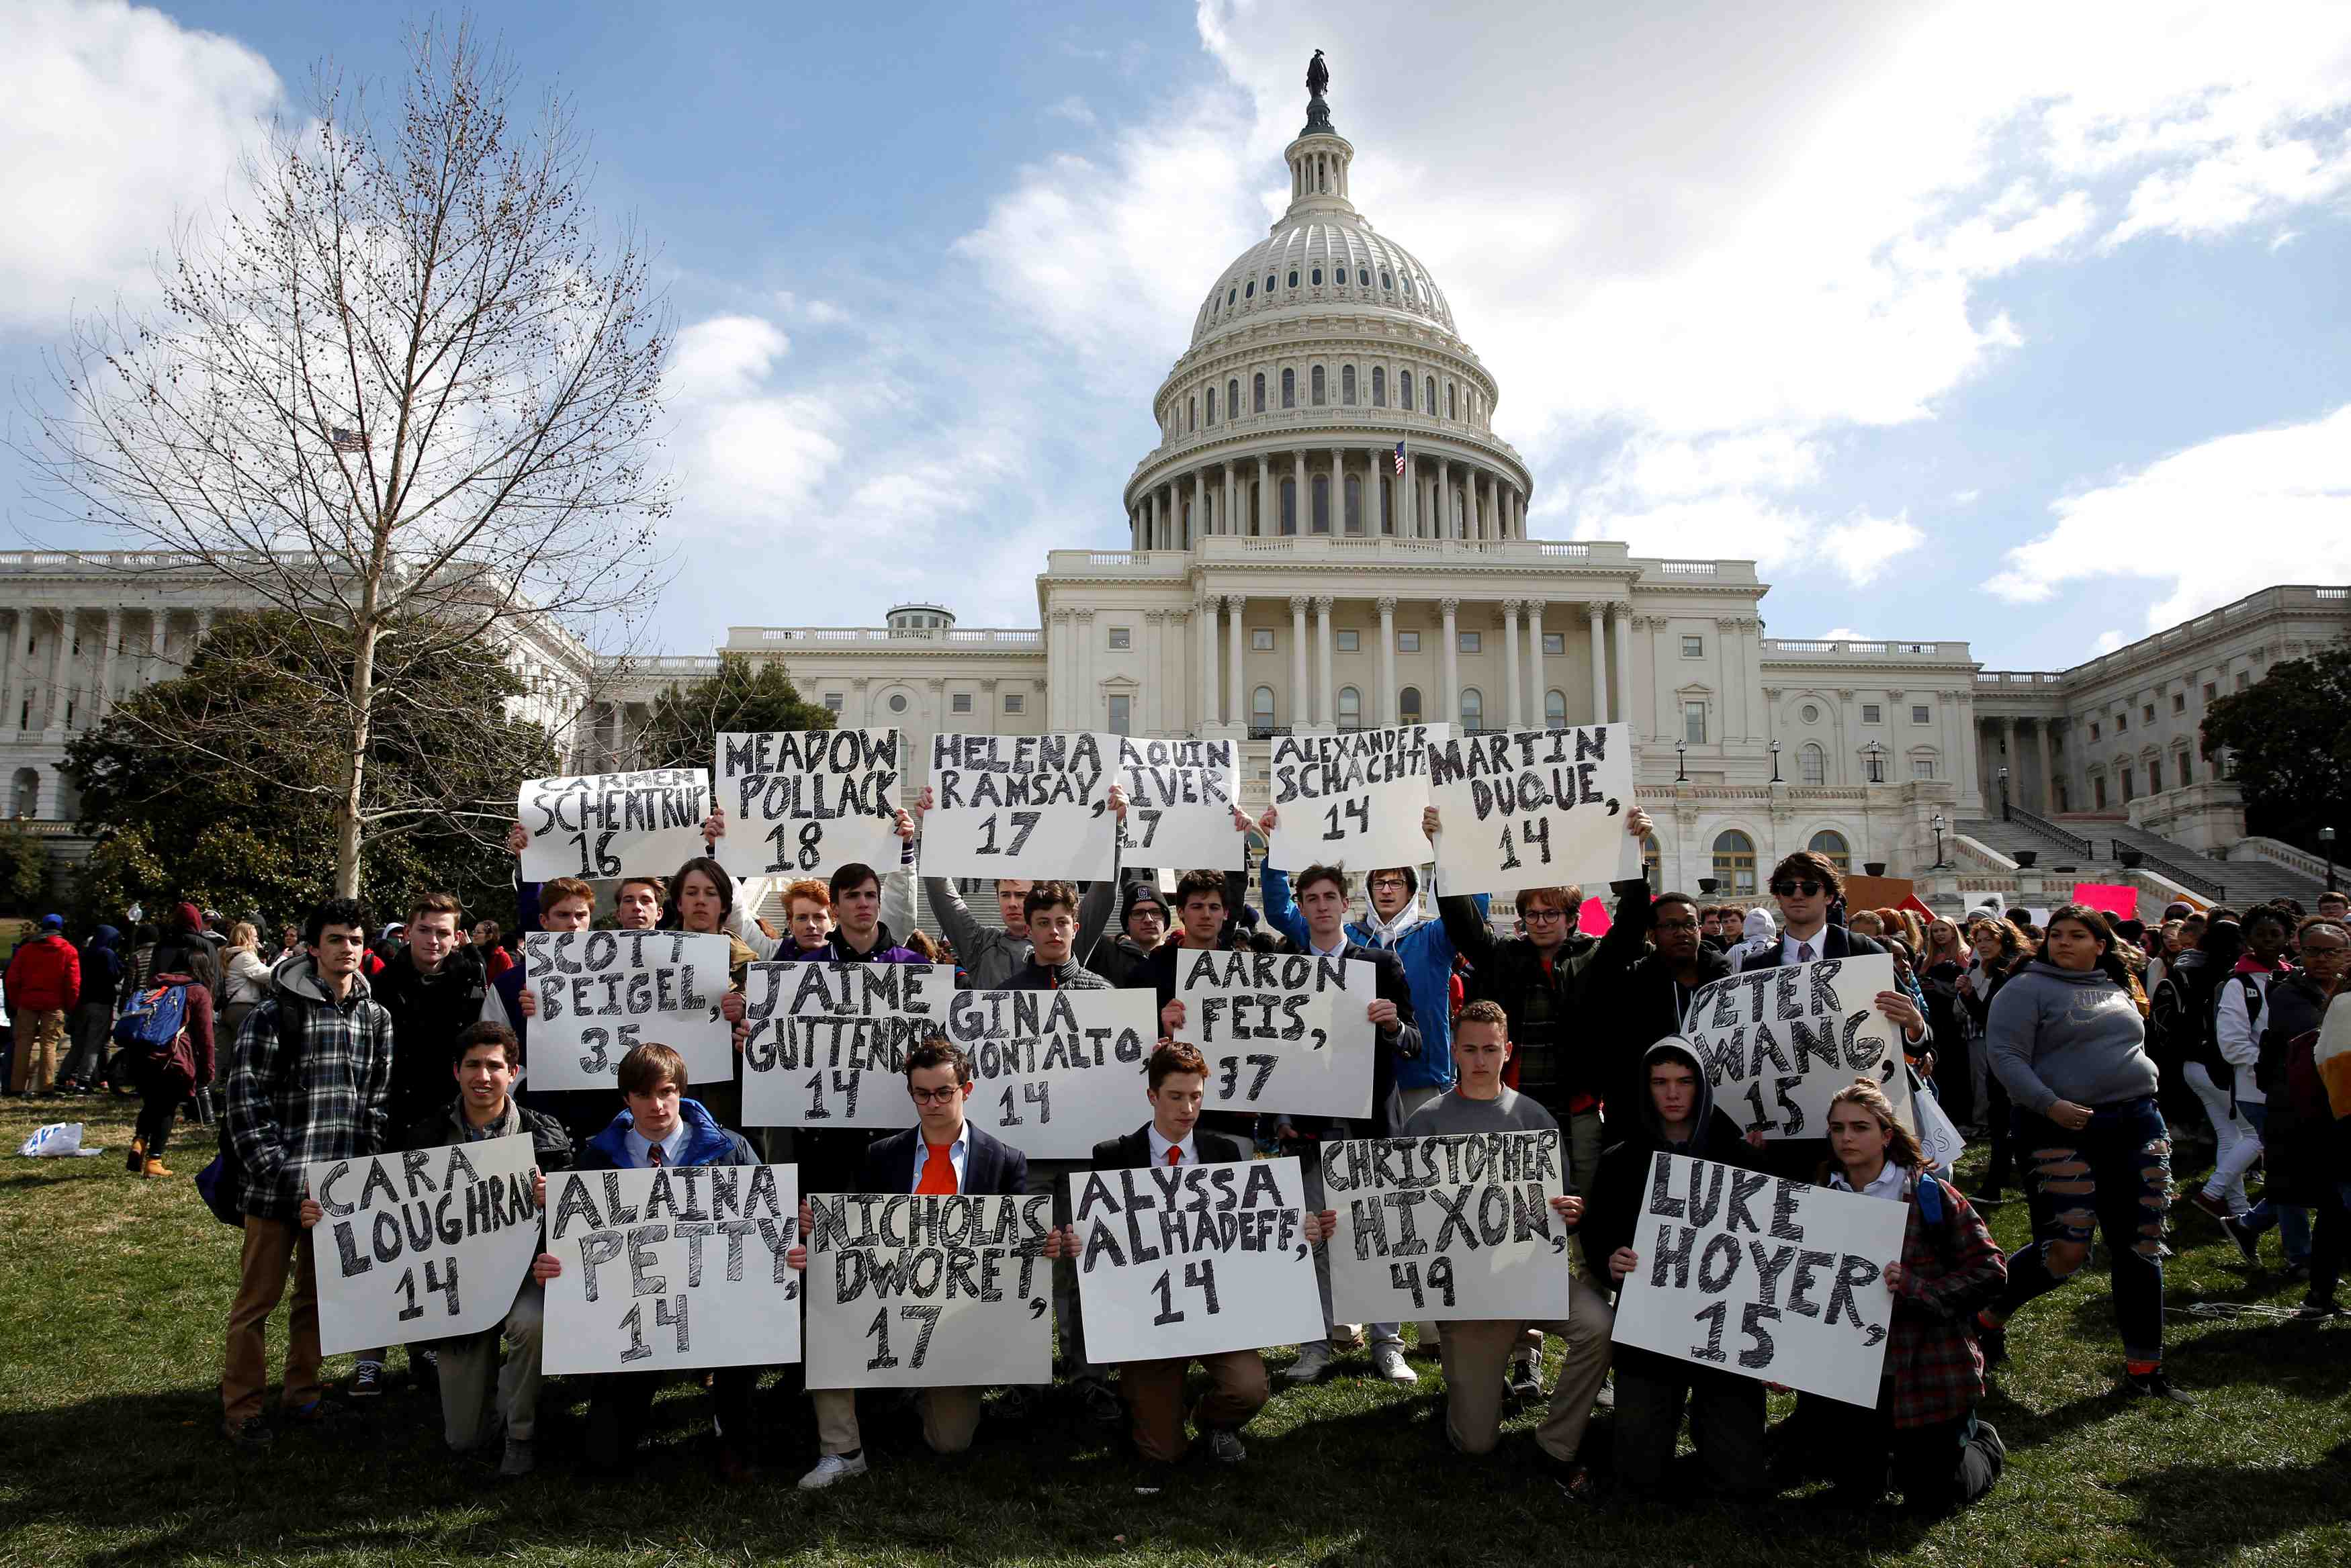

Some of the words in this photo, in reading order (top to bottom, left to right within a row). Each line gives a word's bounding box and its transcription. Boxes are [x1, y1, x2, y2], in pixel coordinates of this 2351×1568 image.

[725, 729, 897, 777] MEADOW
[934, 733, 1102, 774] HELENA
[1274, 726, 1427, 764] ALEXANDER
[1427, 727, 1607, 787] MARTIN
[539, 768, 695, 792] CARMEN
[740, 770, 897, 819] POLLACK
[941, 770, 1106, 818] RAMSAY,
[1471, 763, 1620, 821] DUQUE,
[765, 821, 824, 873] 18
[975, 811, 1041, 856] 17
[1323, 795, 1370, 841] 14
[1499, 817, 1552, 871] 14
[569, 832, 621, 878] 16
[527, 930, 701, 978] SCOTT
[1184, 950, 1347, 993] AARON
[540, 964, 720, 1023] BEIGEL,
[747, 962, 934, 1020] JAIME
[950, 989, 1078, 1042] GINA
[1688, 960, 1842, 1033] PETER
[1202, 993, 1327, 1050] FEIS,
[1694, 1009, 1895, 1088] WANG,
[805, 1069, 860, 1121] 14
[999, 1080, 1051, 1127] 14
[1218, 1054, 1278, 1102] 37
[1744, 1075, 1805, 1136] 15
[320, 1145, 480, 1217] CARA
[1321, 1131, 1558, 1192] CHRISTOPHER
[553, 1165, 781, 1240] ALAINA
[1076, 1164, 1284, 1220] ALYSSA
[1648, 1152, 1811, 1244] LUKE
[811, 1194, 1051, 1254] NICHOLAS
[1083, 1208, 1308, 1273] ALHADEFF,
[1350, 1183, 1566, 1260] HIXON,
[578, 1216, 799, 1302] PETTY,
[836, 1246, 1047, 1320] DWORET,
[1389, 1256, 1456, 1309] 49
[1650, 1223, 1888, 1347] HOYER,
[395, 1256, 460, 1321] 14
[1151, 1258, 1221, 1326] 14
[619, 1294, 689, 1363] 14
[867, 1305, 942, 1371] 17
[1690, 1299, 1783, 1370] 15
